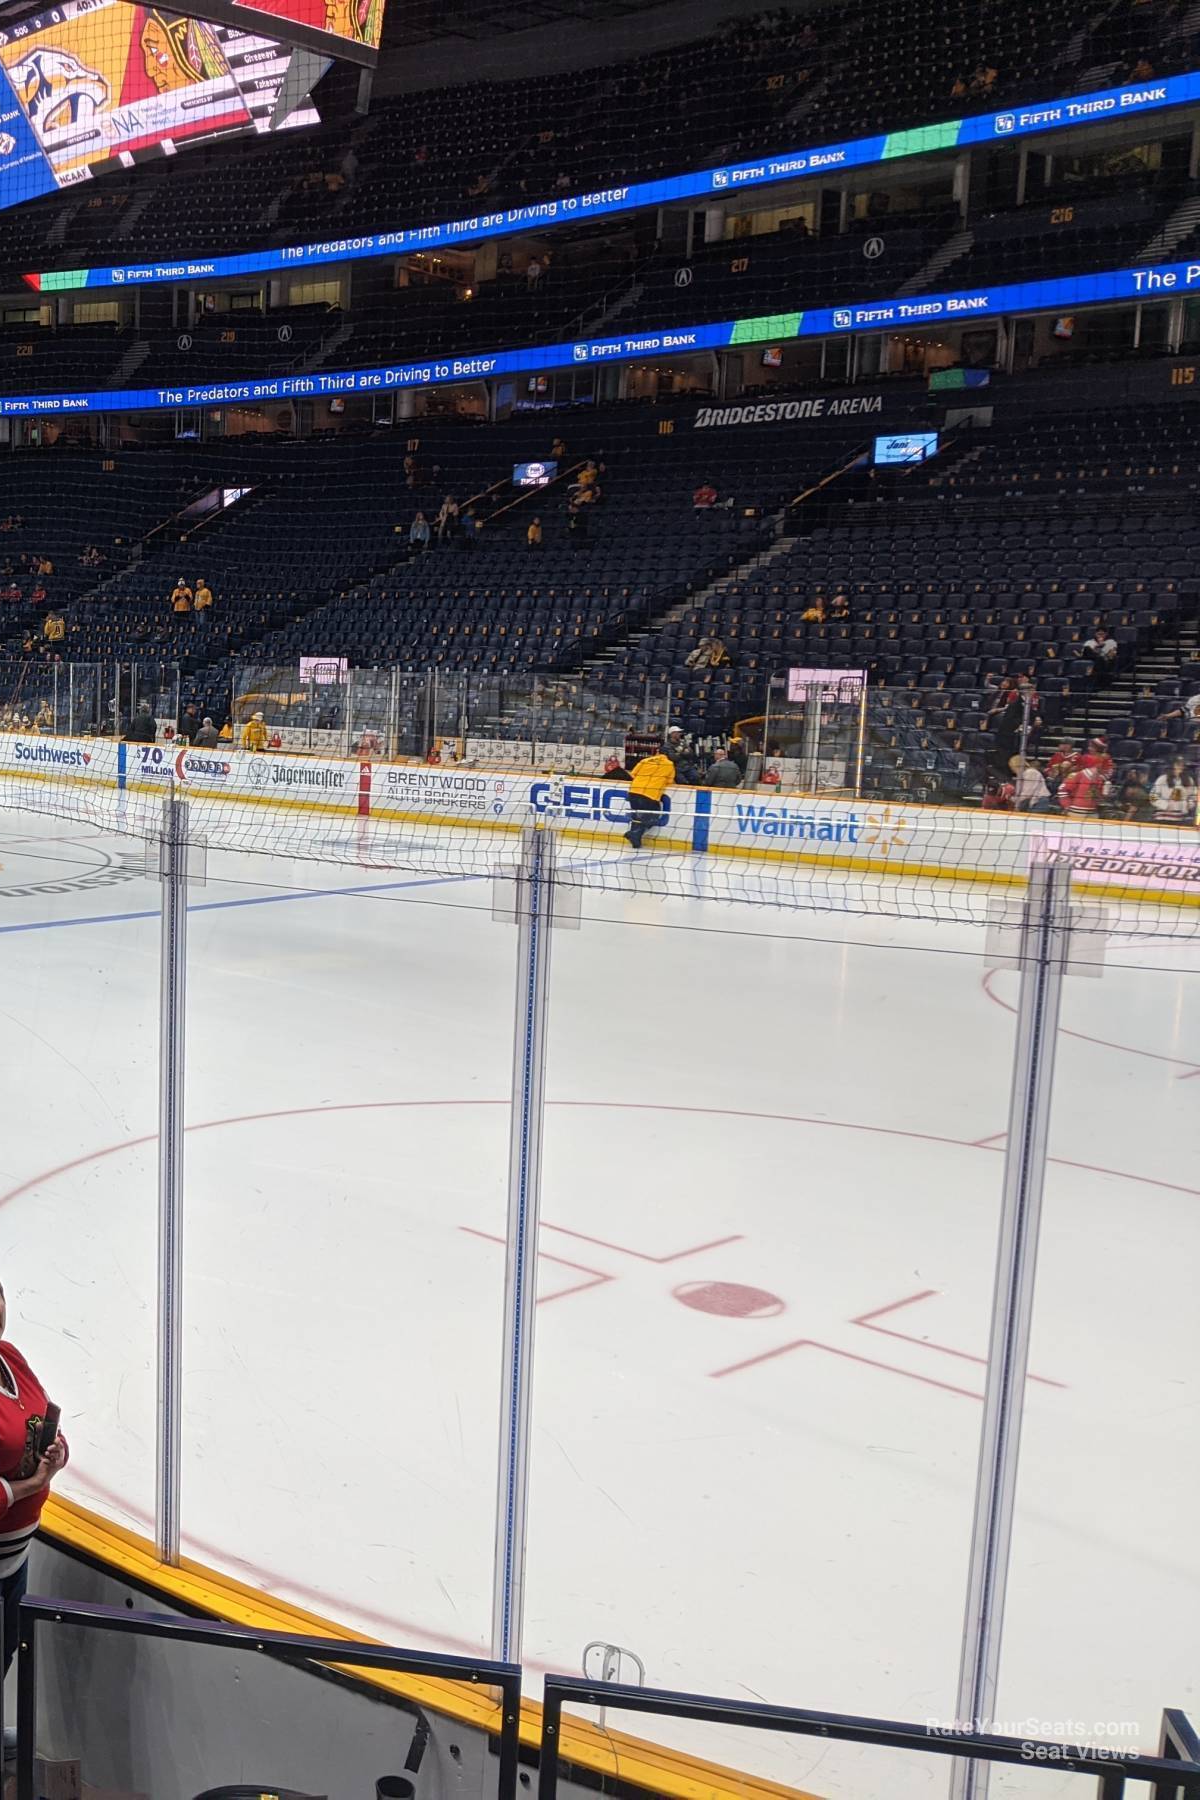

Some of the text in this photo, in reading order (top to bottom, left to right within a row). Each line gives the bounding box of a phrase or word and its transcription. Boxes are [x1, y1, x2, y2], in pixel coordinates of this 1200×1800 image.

[52, 11, 60, 22] 0
[244, 50, 277, 63] Giveaways
[254, 77, 284, 90] Takeaway
[1020, 87, 1166, 126] FIFTH THIRD BANK
[732, 149, 845, 182] FIFTH THIRD BANK
[60, 169, 87, 184] NCAAF
[281, 244, 303, 260] The
[308, 235, 373, 257] Predators
[379, 230, 404, 246] and
[482, 212, 503, 227] are
[508, 200, 557, 222] Driving
[562, 197, 578, 211] to
[582, 186, 629, 207] Better
[1050, 208, 1073, 224] 216
[127, 263, 215, 279] FIFTH THIRD BANK
[731, 257, 748, 273] 217
[1133, 270, 1177, 290] The
[856, 296, 988, 324] FIFTH THIRD BANK
[221, 330, 236, 343] 219
[591, 333, 696, 356] FIFTH THIRD BANK
[16, 345, 33, 356] 220
[158, 357, 496, 404] The Predators and Fifth Third are Driving to Better
[1171, 367, 1195, 385] 115
[4, 398, 89, 411] FIFTH THIRD BANK
[694, 396, 882, 428] BRIDGESTONE ARENA
[658, 420, 674, 435] 116
[15, 742, 82, 766] Southwest
[141, 765, 174, 777] MILLION
[387, 772, 486, 791] BRENTWOOD
[387, 787, 486, 811] AUTO BROKERS
[737, 804, 861, 843] Walmart
[1048, 850, 1200, 881] PREDATOR
